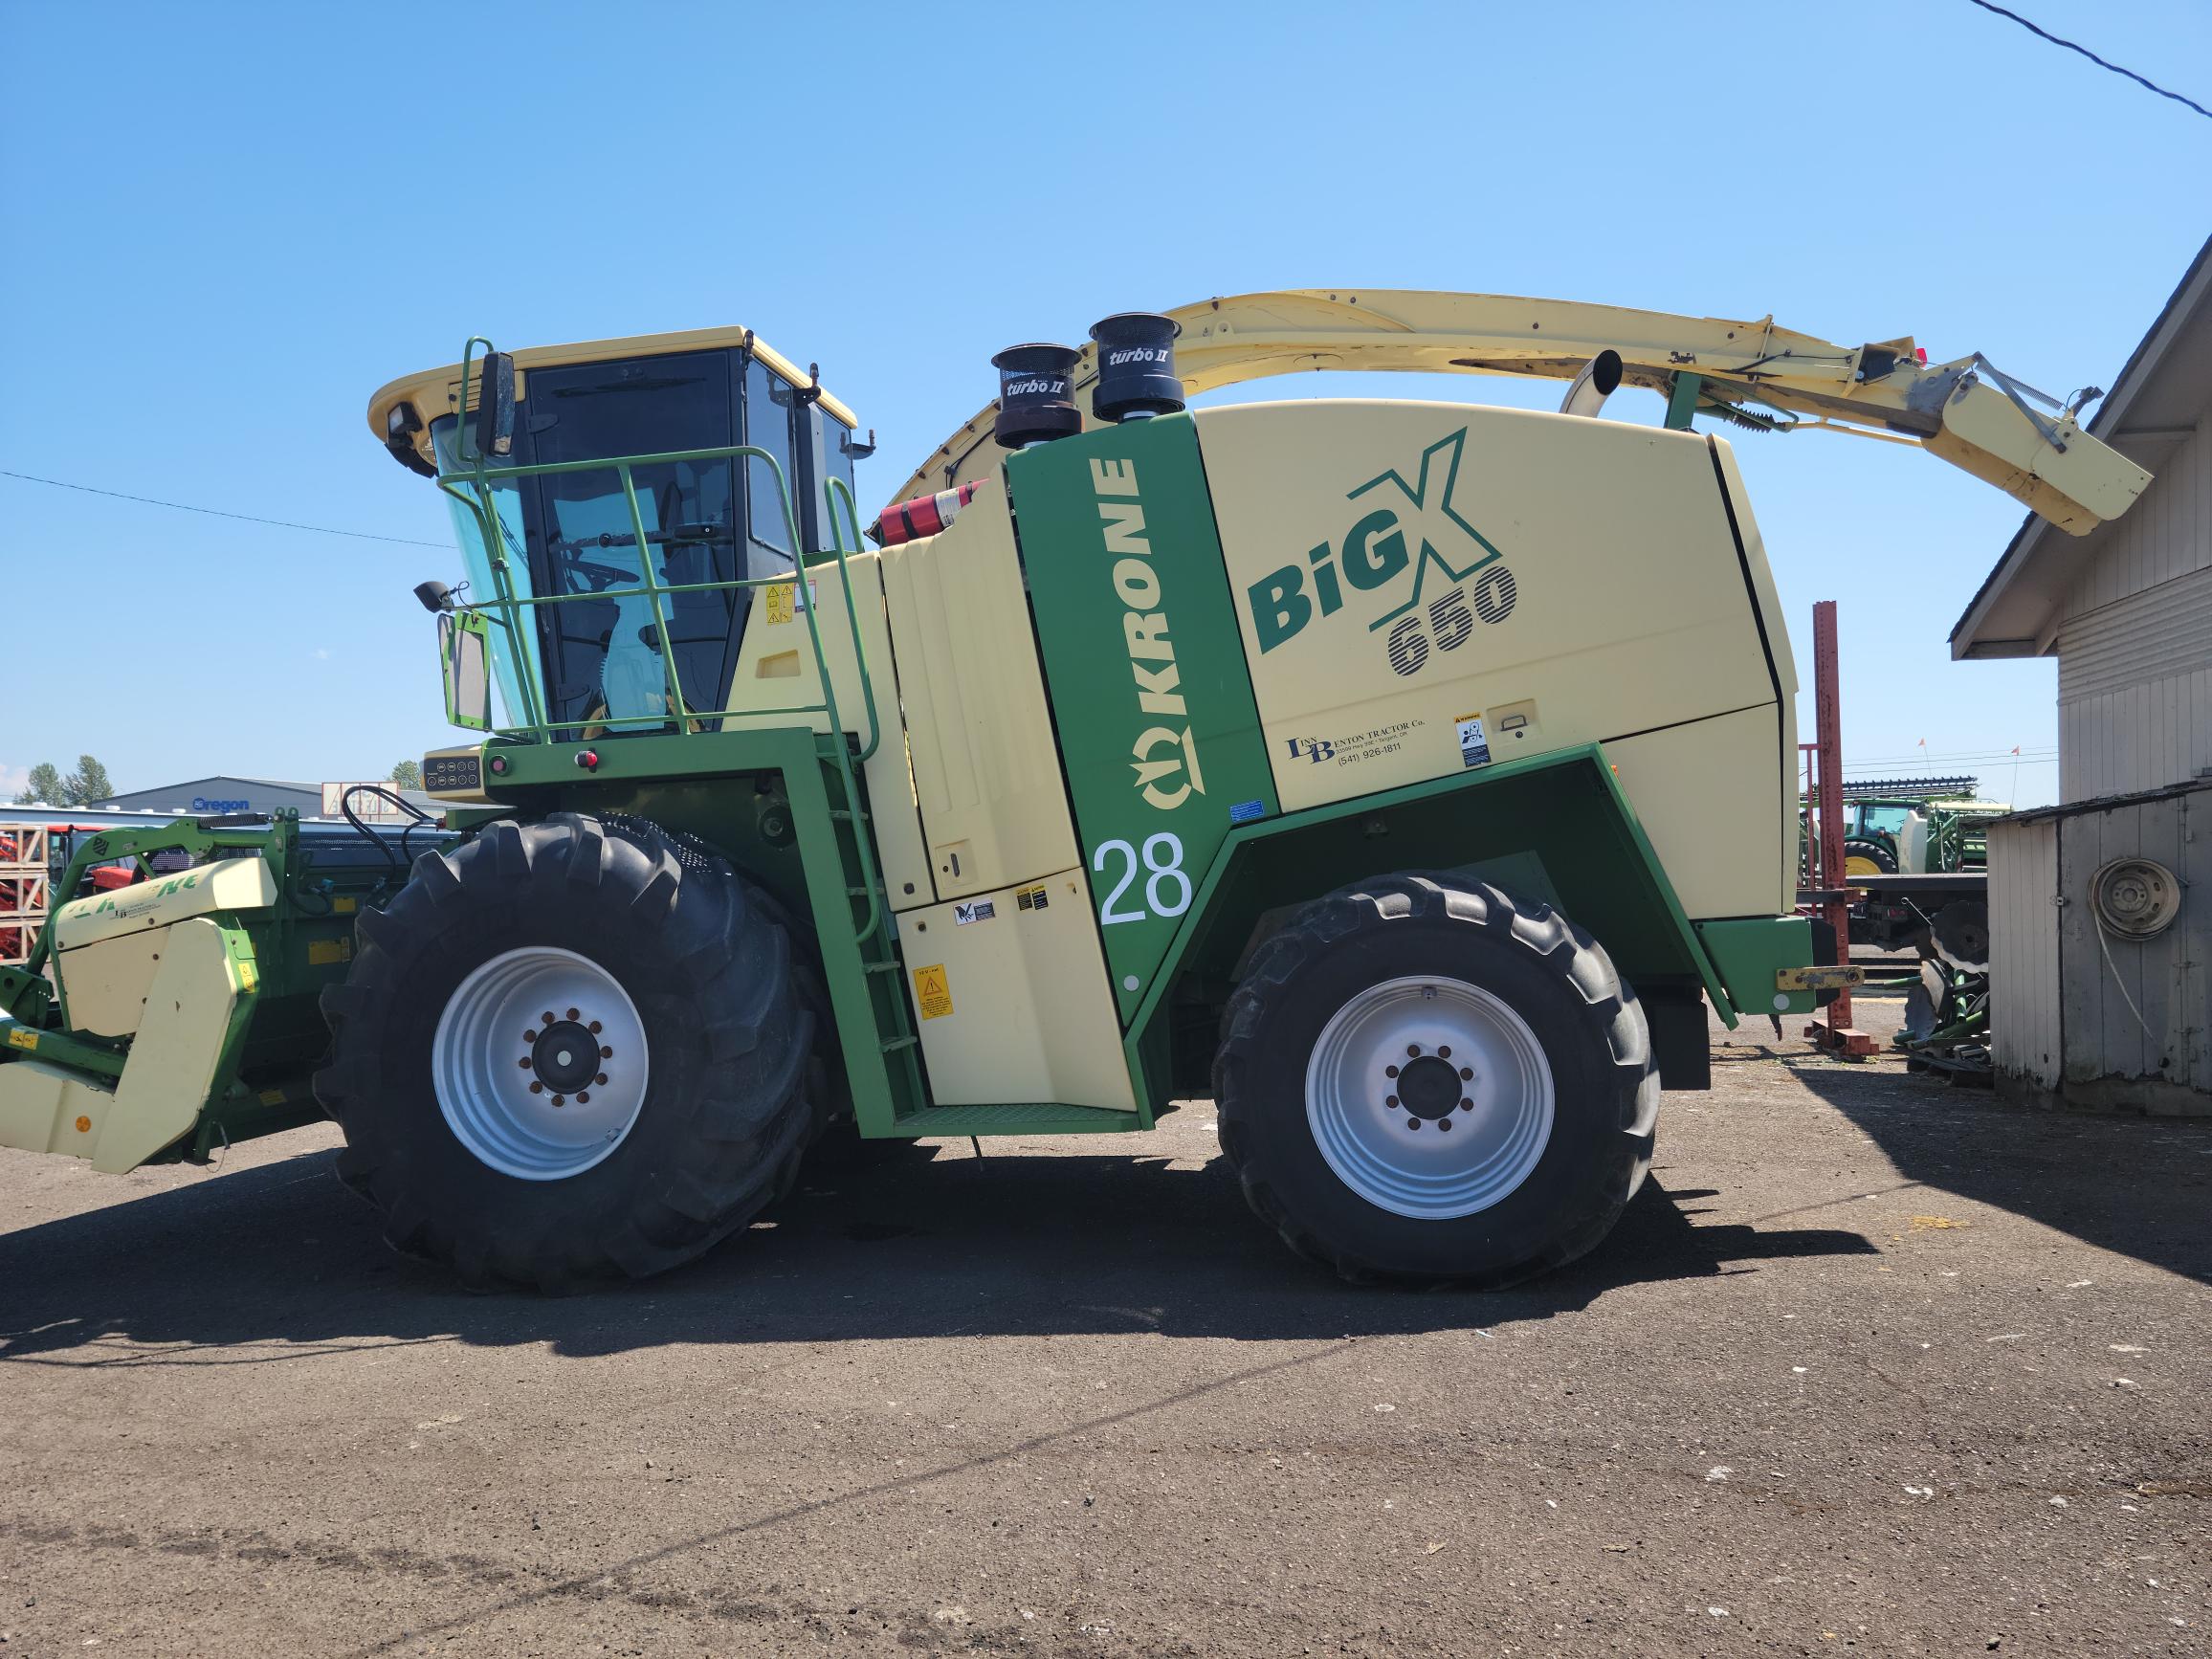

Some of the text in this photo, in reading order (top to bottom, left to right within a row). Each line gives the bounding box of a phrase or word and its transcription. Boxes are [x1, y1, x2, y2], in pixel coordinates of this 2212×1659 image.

[1109, 347, 1154, 365] turbo
[1006, 379, 1049, 397] turbo
[1089, 458, 1187, 716] KRONE
[1387, 565, 1517, 676] 650
[1367, 721, 1410, 740] TRACTOR
[1411, 719, 1426, 728] Co.
[1338, 741, 1402, 766] (541) 926-1811
[193, 798, 249, 812] Oregon
[1094, 831, 1192, 926] 28
